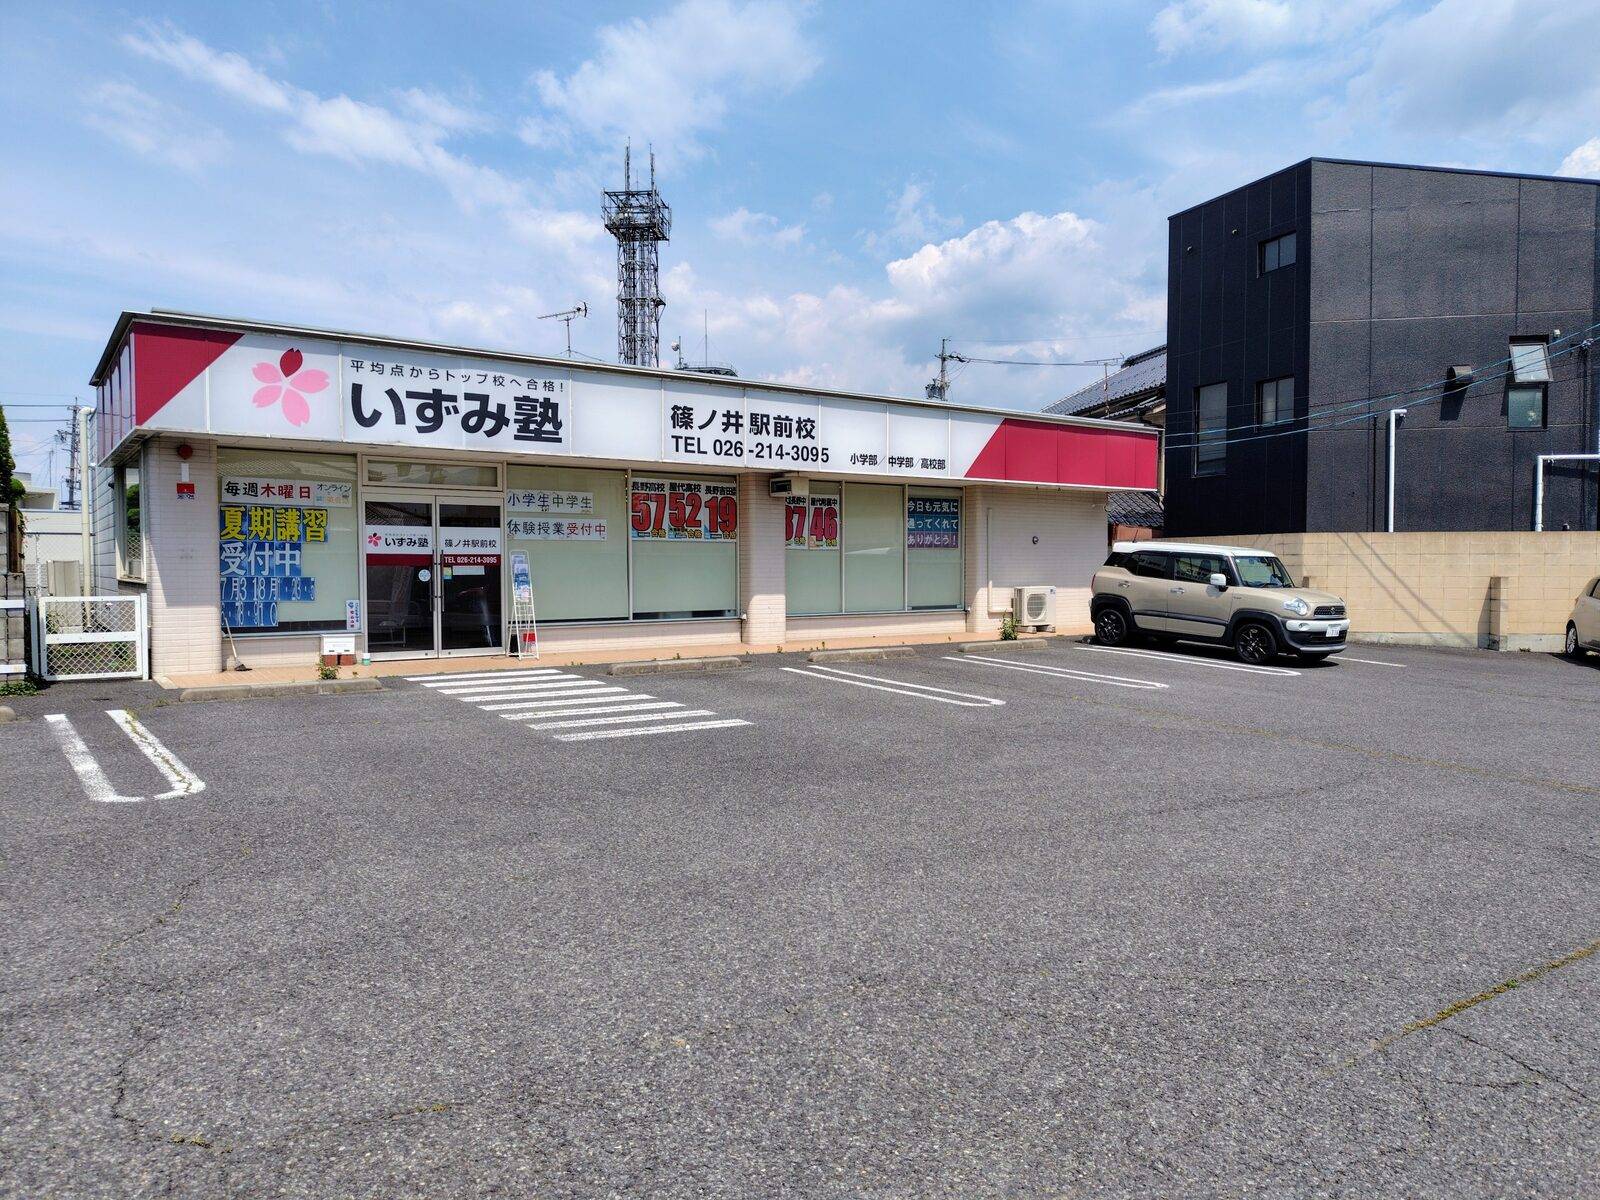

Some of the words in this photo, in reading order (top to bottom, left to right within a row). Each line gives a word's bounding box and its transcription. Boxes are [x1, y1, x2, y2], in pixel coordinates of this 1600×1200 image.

[350, 359, 564, 393] 平均点からトップ校へ合格!
[351, 382, 563, 443] いずみ塾
[670, 404, 817, 440] 篠ノ井駅前校
[671, 435, 708, 455] TEL
[224, 480, 311, 500] 毎週木曜日
[908, 500, 958, 512] 今日も元気に
[220, 505, 328, 542] 夏期講習
[507, 519, 606, 536] 体験授業受付中
[631, 492, 667, 532] 57
[668, 492, 703, 528] 52
[704, 495, 738, 534] 19
[810, 506, 838, 542] 46
[220, 541, 301, 576] 受付中
[444, 539, 497, 548] 篠ノ井駅前校
[444, 556, 456, 564] TEL
